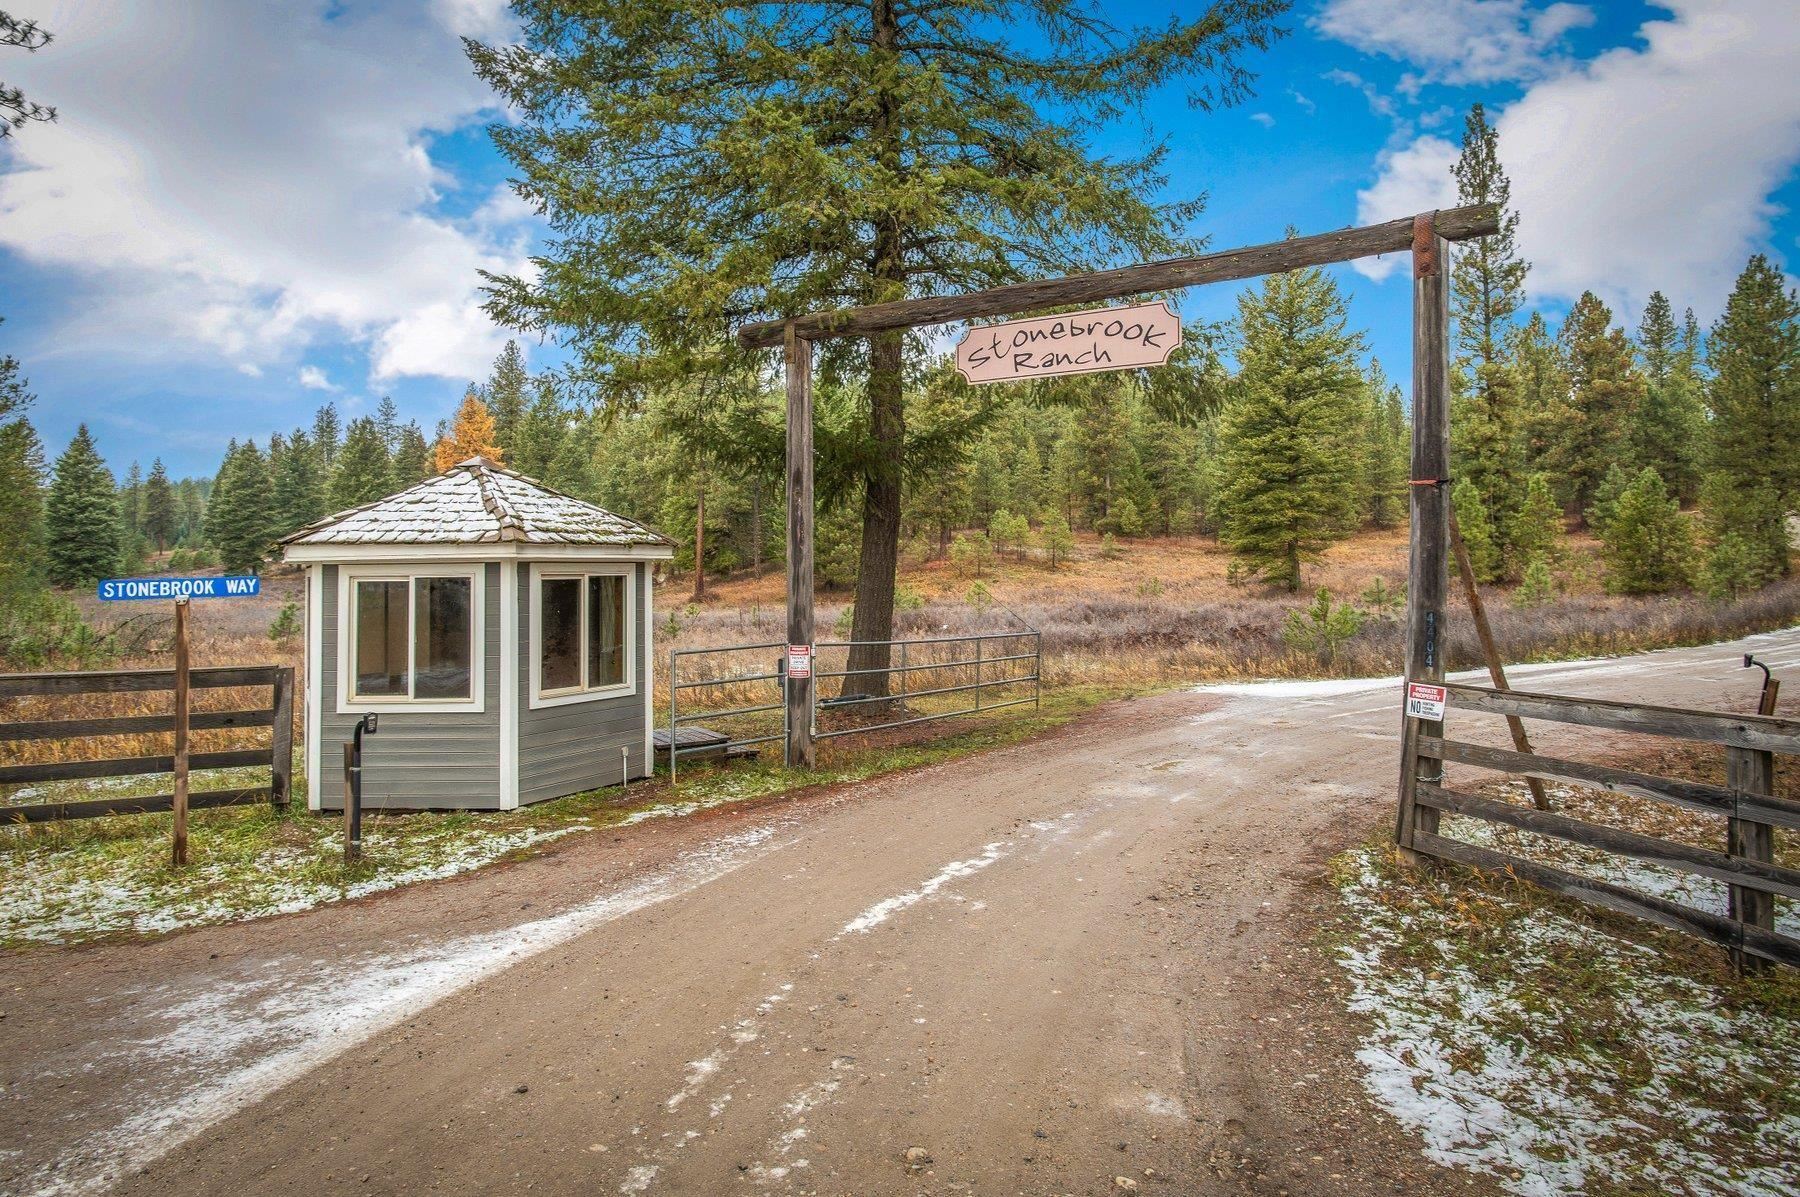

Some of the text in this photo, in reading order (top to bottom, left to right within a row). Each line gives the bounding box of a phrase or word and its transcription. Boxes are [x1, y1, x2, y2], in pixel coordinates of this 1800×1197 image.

[1014, 342, 1112, 372] Ranch
[103, 578, 257, 598] STONEBROOK WAY
[1412, 691, 1441, 701] PROPERTY
[1415, 686, 1438, 695] PRIVATE
[1410, 700, 1421, 714] NO
